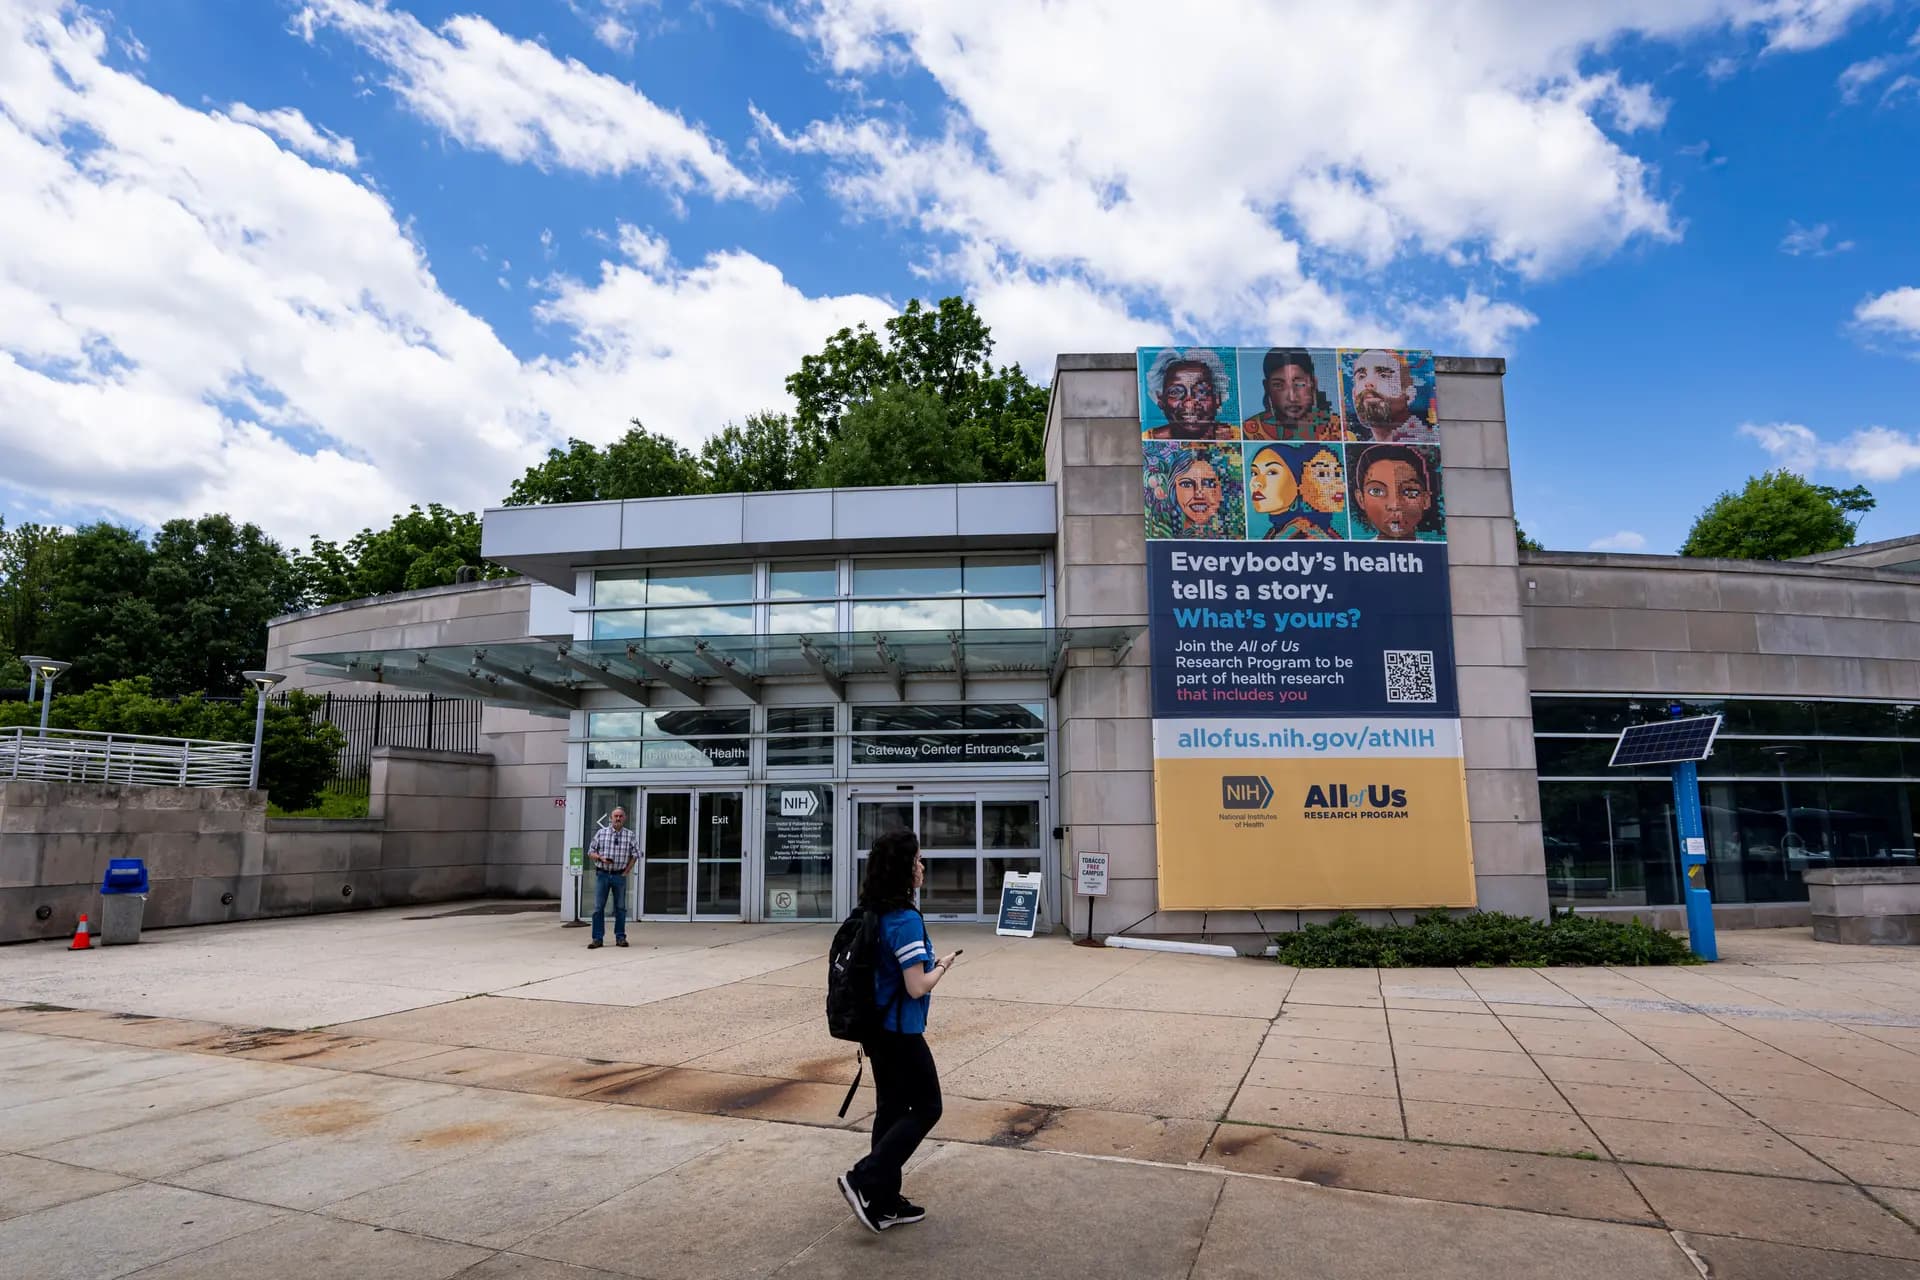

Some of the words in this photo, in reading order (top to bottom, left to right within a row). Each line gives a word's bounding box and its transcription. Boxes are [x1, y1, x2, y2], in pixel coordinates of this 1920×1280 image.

[1171, 552, 1336, 575] Everybody's
[1344, 552, 1423, 573] health
[1172, 579, 1227, 600] tells
[1235, 584, 1250, 600] a
[1258, 581, 1333, 603] story.
[1173, 608, 1266, 628] What's
[1274, 608, 1361, 632] yours?
[1175, 640, 1206, 652] Join
[1210, 640, 1234, 652] the
[1237, 640, 1258, 652] All
[1261, 640, 1278, 652] of
[1281, 640, 1300, 652] Us
[1176, 656, 1243, 668] Research
[1247, 657, 1311, 671] Program
[1315, 657, 1331, 668] to
[1335, 656, 1353, 668] be
[1176, 673, 1208, 686] part
[1212, 672, 1227, 684] of
[1231, 672, 1276, 684] health
[1281, 672, 1345, 684] research
[1176, 688, 1208, 701] that
[1213, 688, 1274, 701] includes
[1279, 690, 1308, 703] you
[1178, 726, 1435, 751] allofus.nih.gov/atNIH
[709, 748, 745, 759] Health
[866, 744, 918, 757] Gateway
[921, 743, 962, 755] Center
[965, 743, 1020, 755] Entrance
[1226, 784, 1260, 801] NIH
[1304, 783, 1348, 808] All
[1348, 789, 1368, 808] of
[1368, 784, 1407, 808] Us
[784, 797, 808, 809] NIH
[660, 815, 677, 825] Exit
[711, 815, 729, 825] Exit
[1304, 811, 1357, 819] RESEARCH
[1360, 811, 1408, 819] PROGRAM
